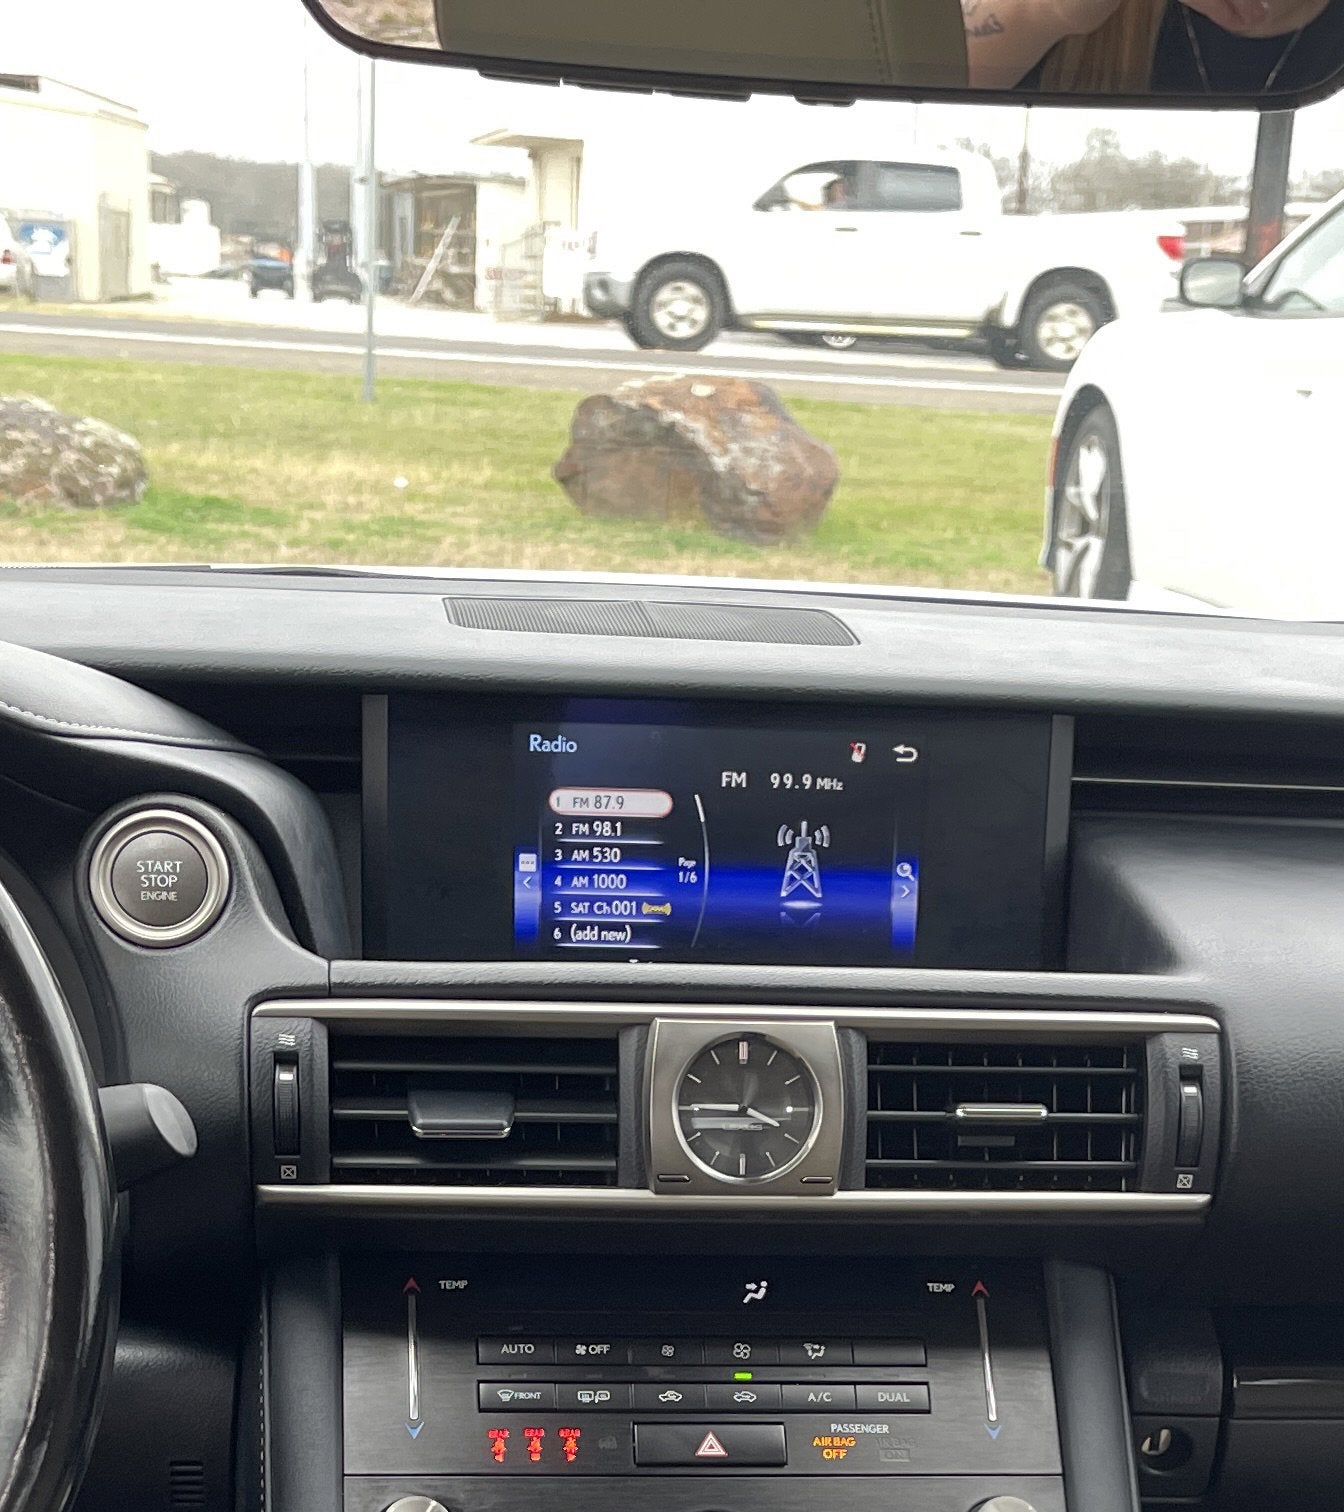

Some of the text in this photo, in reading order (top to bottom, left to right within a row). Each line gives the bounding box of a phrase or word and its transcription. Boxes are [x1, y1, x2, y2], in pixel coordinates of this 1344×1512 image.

[529, 734, 577, 753] Radio
[721, 771, 843, 790] FM 99.9 MHz
[572, 797, 589, 808] FM
[594, 795, 624, 810] 87.9
[555, 821, 622, 836] 2 FM 98.1
[555, 847, 621, 863] 3 AM 530
[136, 861, 183, 873] START
[141, 875, 178, 887] STOP
[554, 874, 627, 889] 4 AM 1000
[678, 871, 697, 883] 1/6
[140, 891, 178, 901] ENGINE
[554, 902, 562, 913] 5
[571, 902, 590, 914] SAT
[553, 923, 631, 943] 6 (add new)
[438, 1279, 468, 1290] TEMP
[926, 1282, 956, 1293] TEMP
[501, 1343, 535, 1355] AUTO
[588, 1344, 611, 1355] OFF
[514, 1390, 542, 1400] FRONT
[807, 1391, 832, 1403] A/C
[877, 1391, 911, 1403] DUAL
[830, 1423, 890, 1434] PASSENGER
[822, 1448, 848, 1460] OFF
